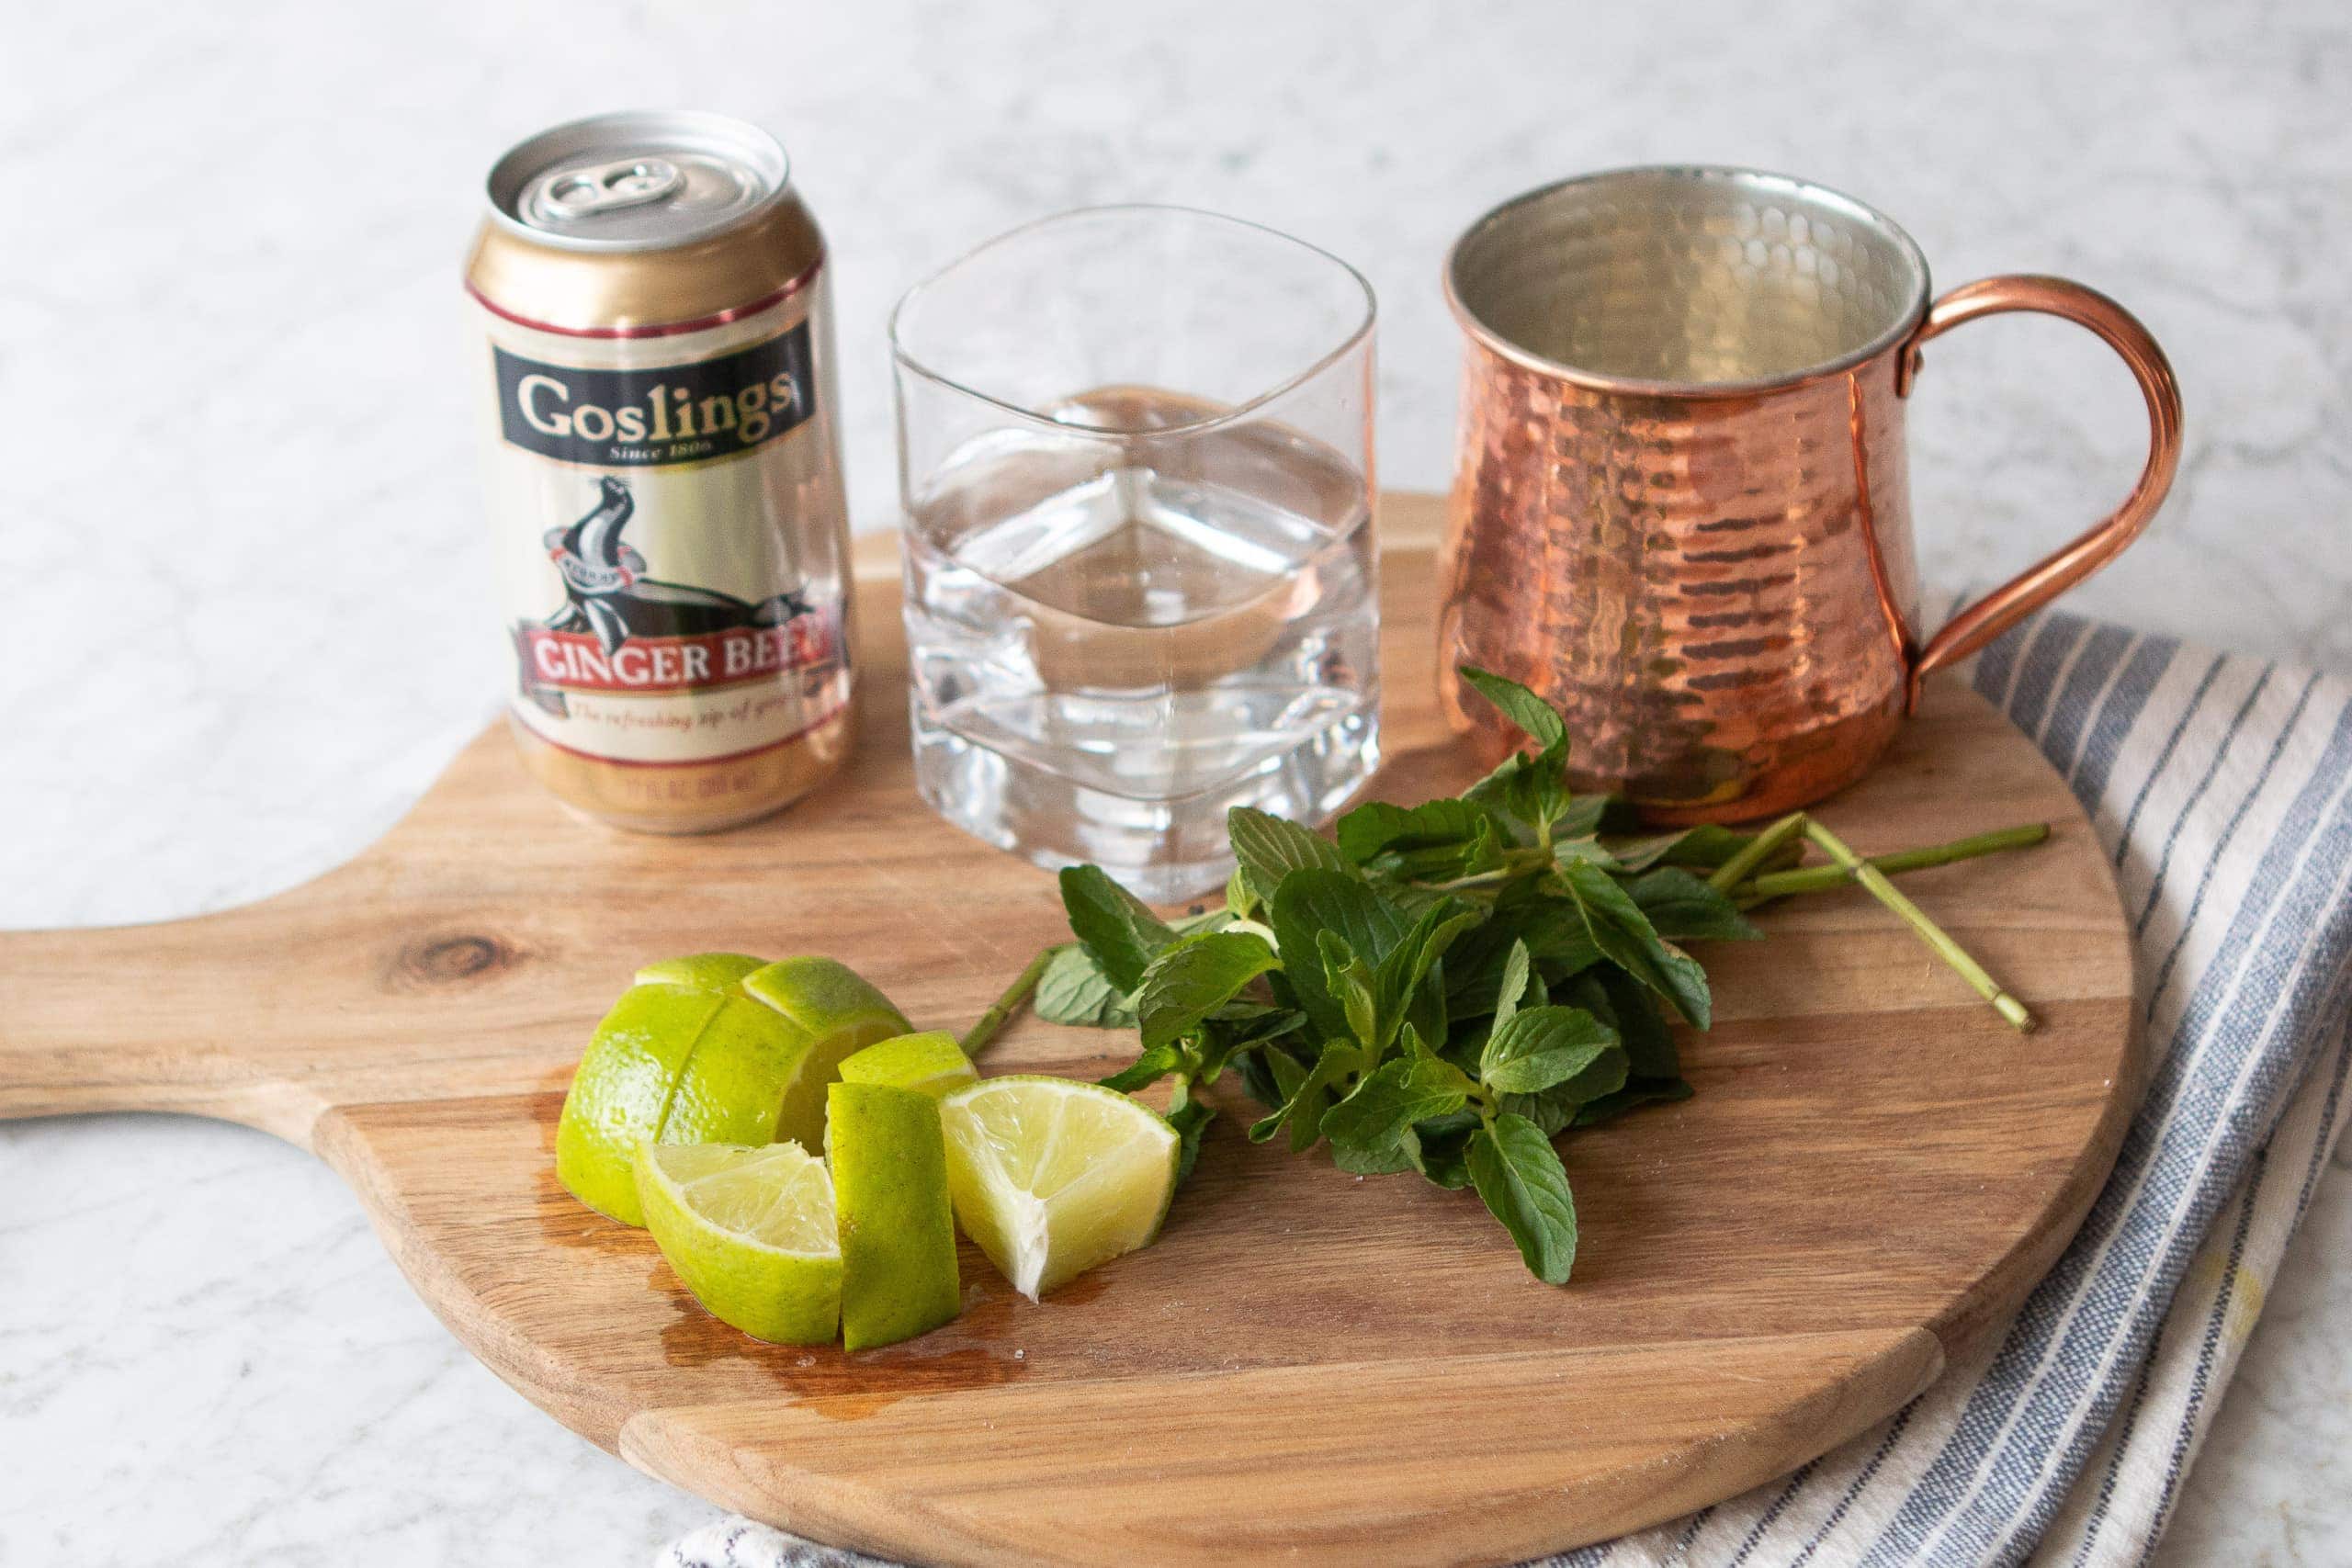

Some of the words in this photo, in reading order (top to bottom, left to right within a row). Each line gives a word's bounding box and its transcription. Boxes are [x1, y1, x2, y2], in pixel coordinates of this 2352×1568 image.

[517, 372, 794, 445] Goslings
[609, 445, 662, 459] Since
[534, 637, 711, 686] GINGER
